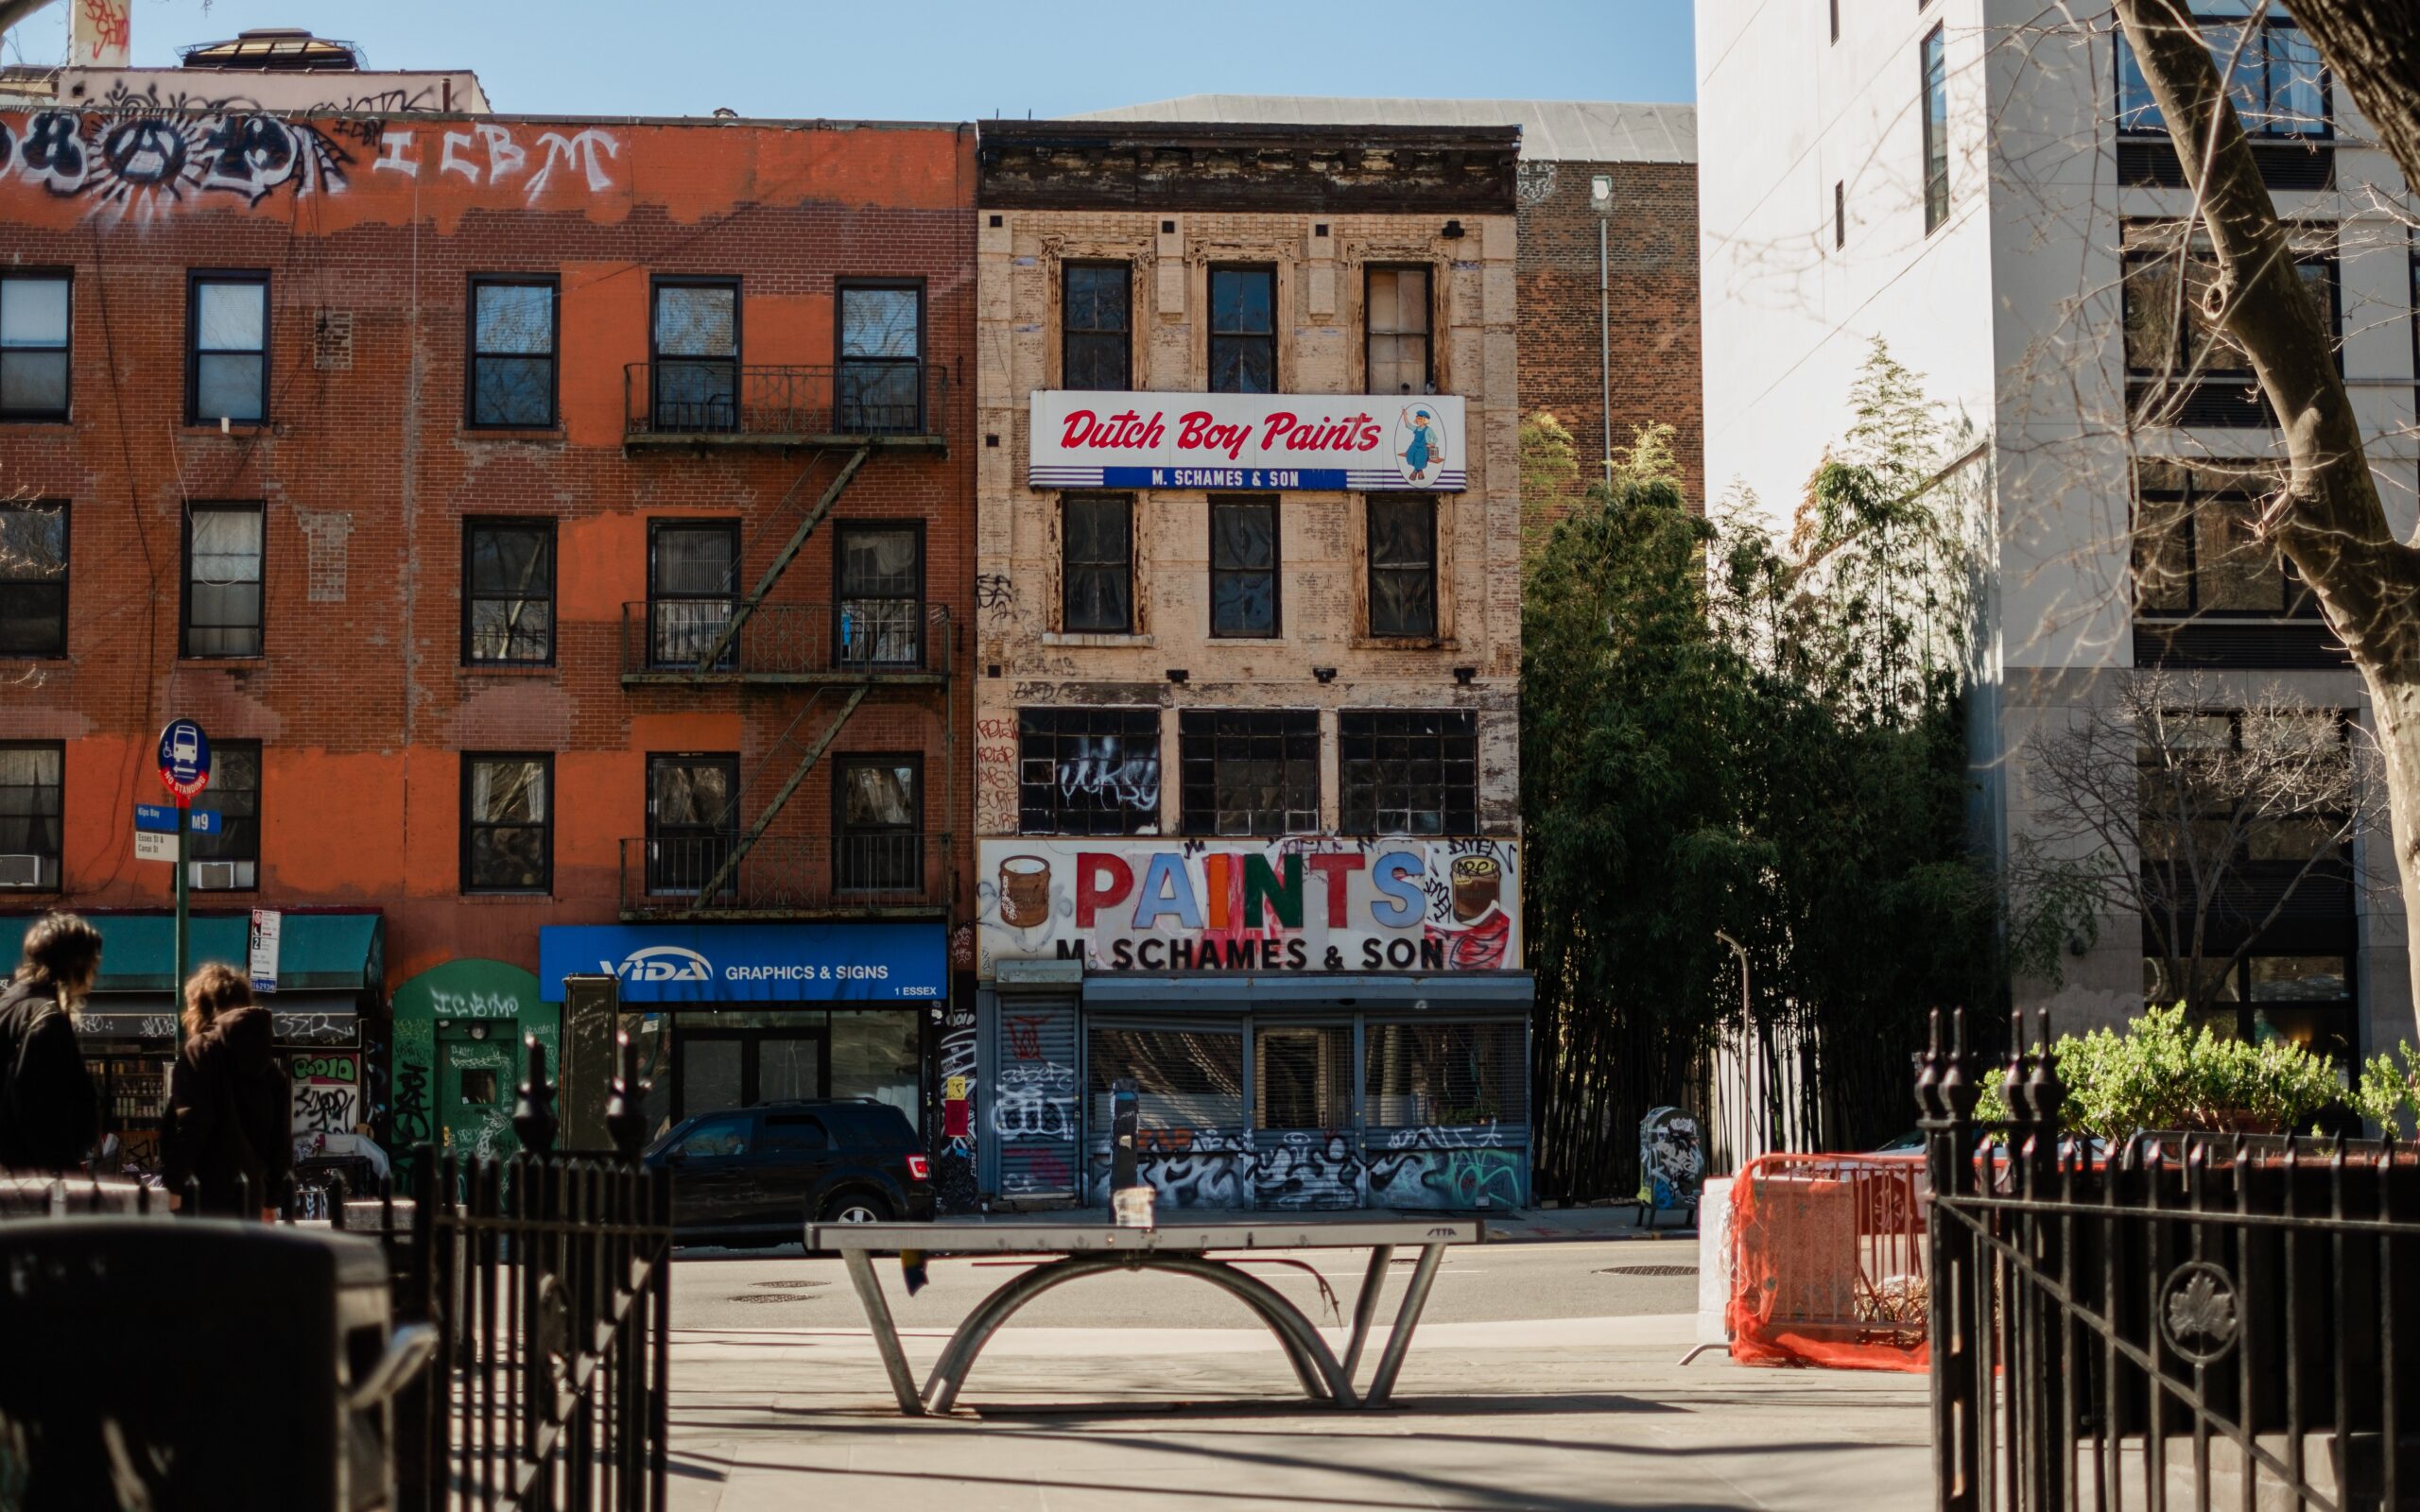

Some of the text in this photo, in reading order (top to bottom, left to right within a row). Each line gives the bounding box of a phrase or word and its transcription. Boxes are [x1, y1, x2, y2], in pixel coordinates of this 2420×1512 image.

[1061, 409, 1382, 460] Dutch Boy Paints
[1151, 469, 1299, 488] M. SCHAMES & SON
[164, 770, 206, 794] NO STANDING
[191, 813, 209, 831] M9
[138, 833, 152, 843] Essex
[137, 843, 151, 853] Canal
[1076, 850, 1426, 929] PAINTS
[1112, 937, 1307, 971] SCHAMES
[1324, 945, 1344, 970] &
[1361, 937, 1444, 971] SON
[724, 965, 815, 980] GRAPHICS
[819, 965, 832, 980] &
[836, 965, 890, 980] SIGNS
[894, 987, 938, 996] 1 ESSEX
